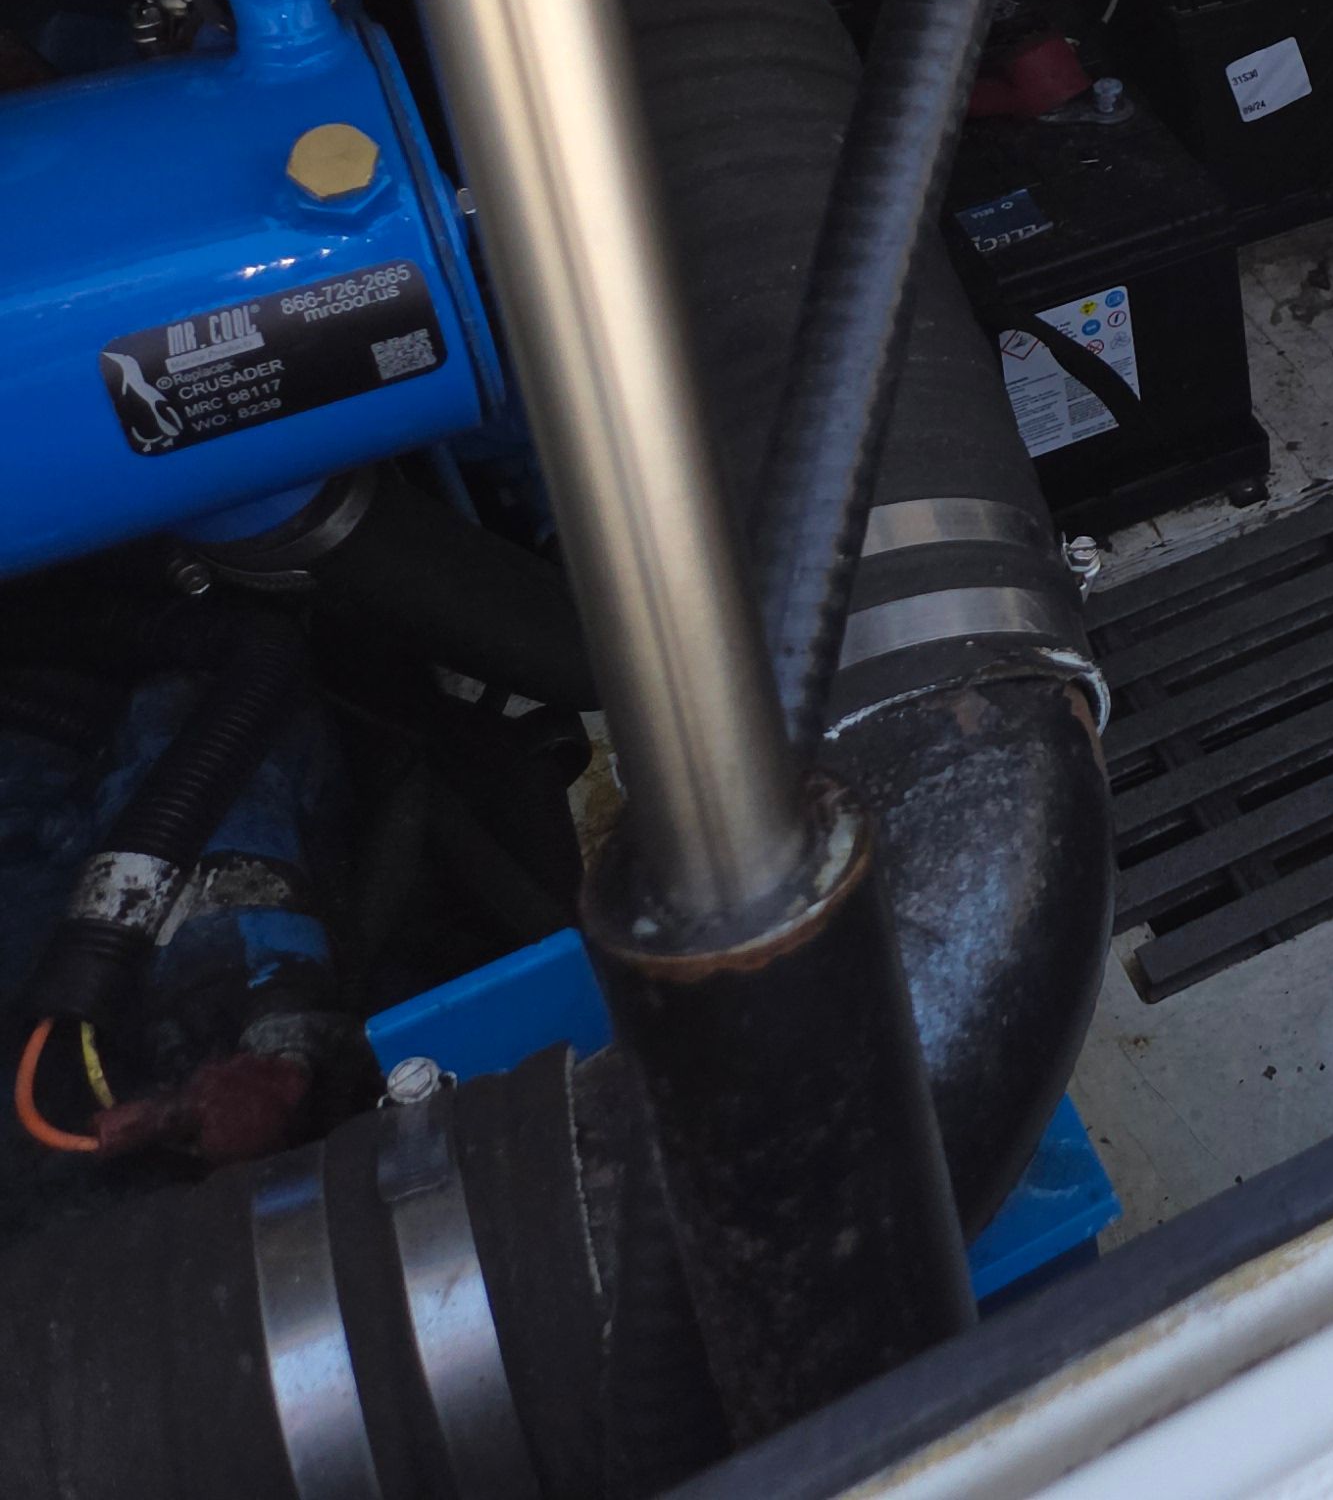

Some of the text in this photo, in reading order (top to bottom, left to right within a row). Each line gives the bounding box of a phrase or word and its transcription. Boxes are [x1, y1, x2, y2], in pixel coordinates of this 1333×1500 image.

[280, 264, 412, 315] 866-726-2665
[303, 285, 400, 322] mrcool.us
[178, 359, 286, 400] CRUSADER
[184, 379, 281, 418] MRC 98117
[238, 397, 282, 419] 8239
